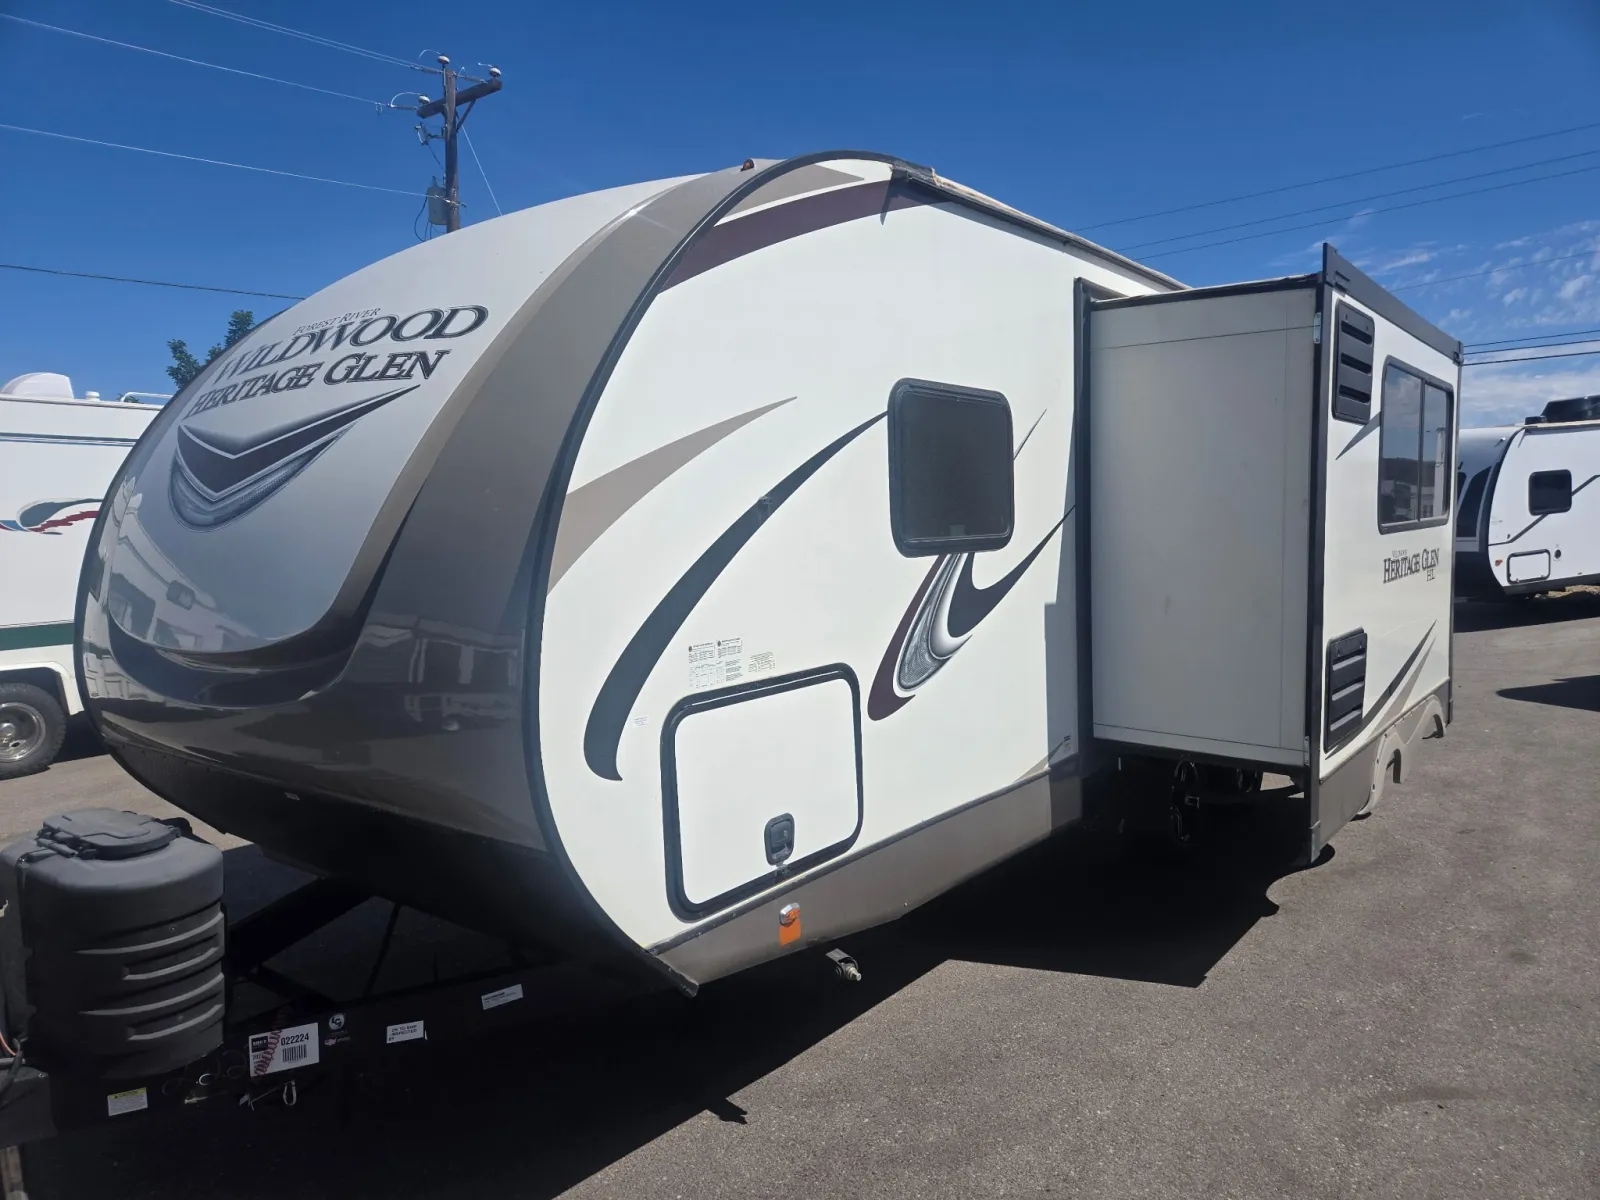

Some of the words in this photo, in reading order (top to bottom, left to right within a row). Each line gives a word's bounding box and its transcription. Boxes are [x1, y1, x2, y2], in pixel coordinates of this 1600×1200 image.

[293, 315, 341, 336] FOREST
[341, 307, 381, 323] RIVER
[212, 304, 489, 386] WILDWOOD
[185, 362, 325, 418] HERITAGE
[324, 349, 451, 385] GLEN
[1383, 553, 1421, 584] HERITAGE
[1421, 548, 1440, 571] GLEN
[281, 1033, 309, 1046] 022224
